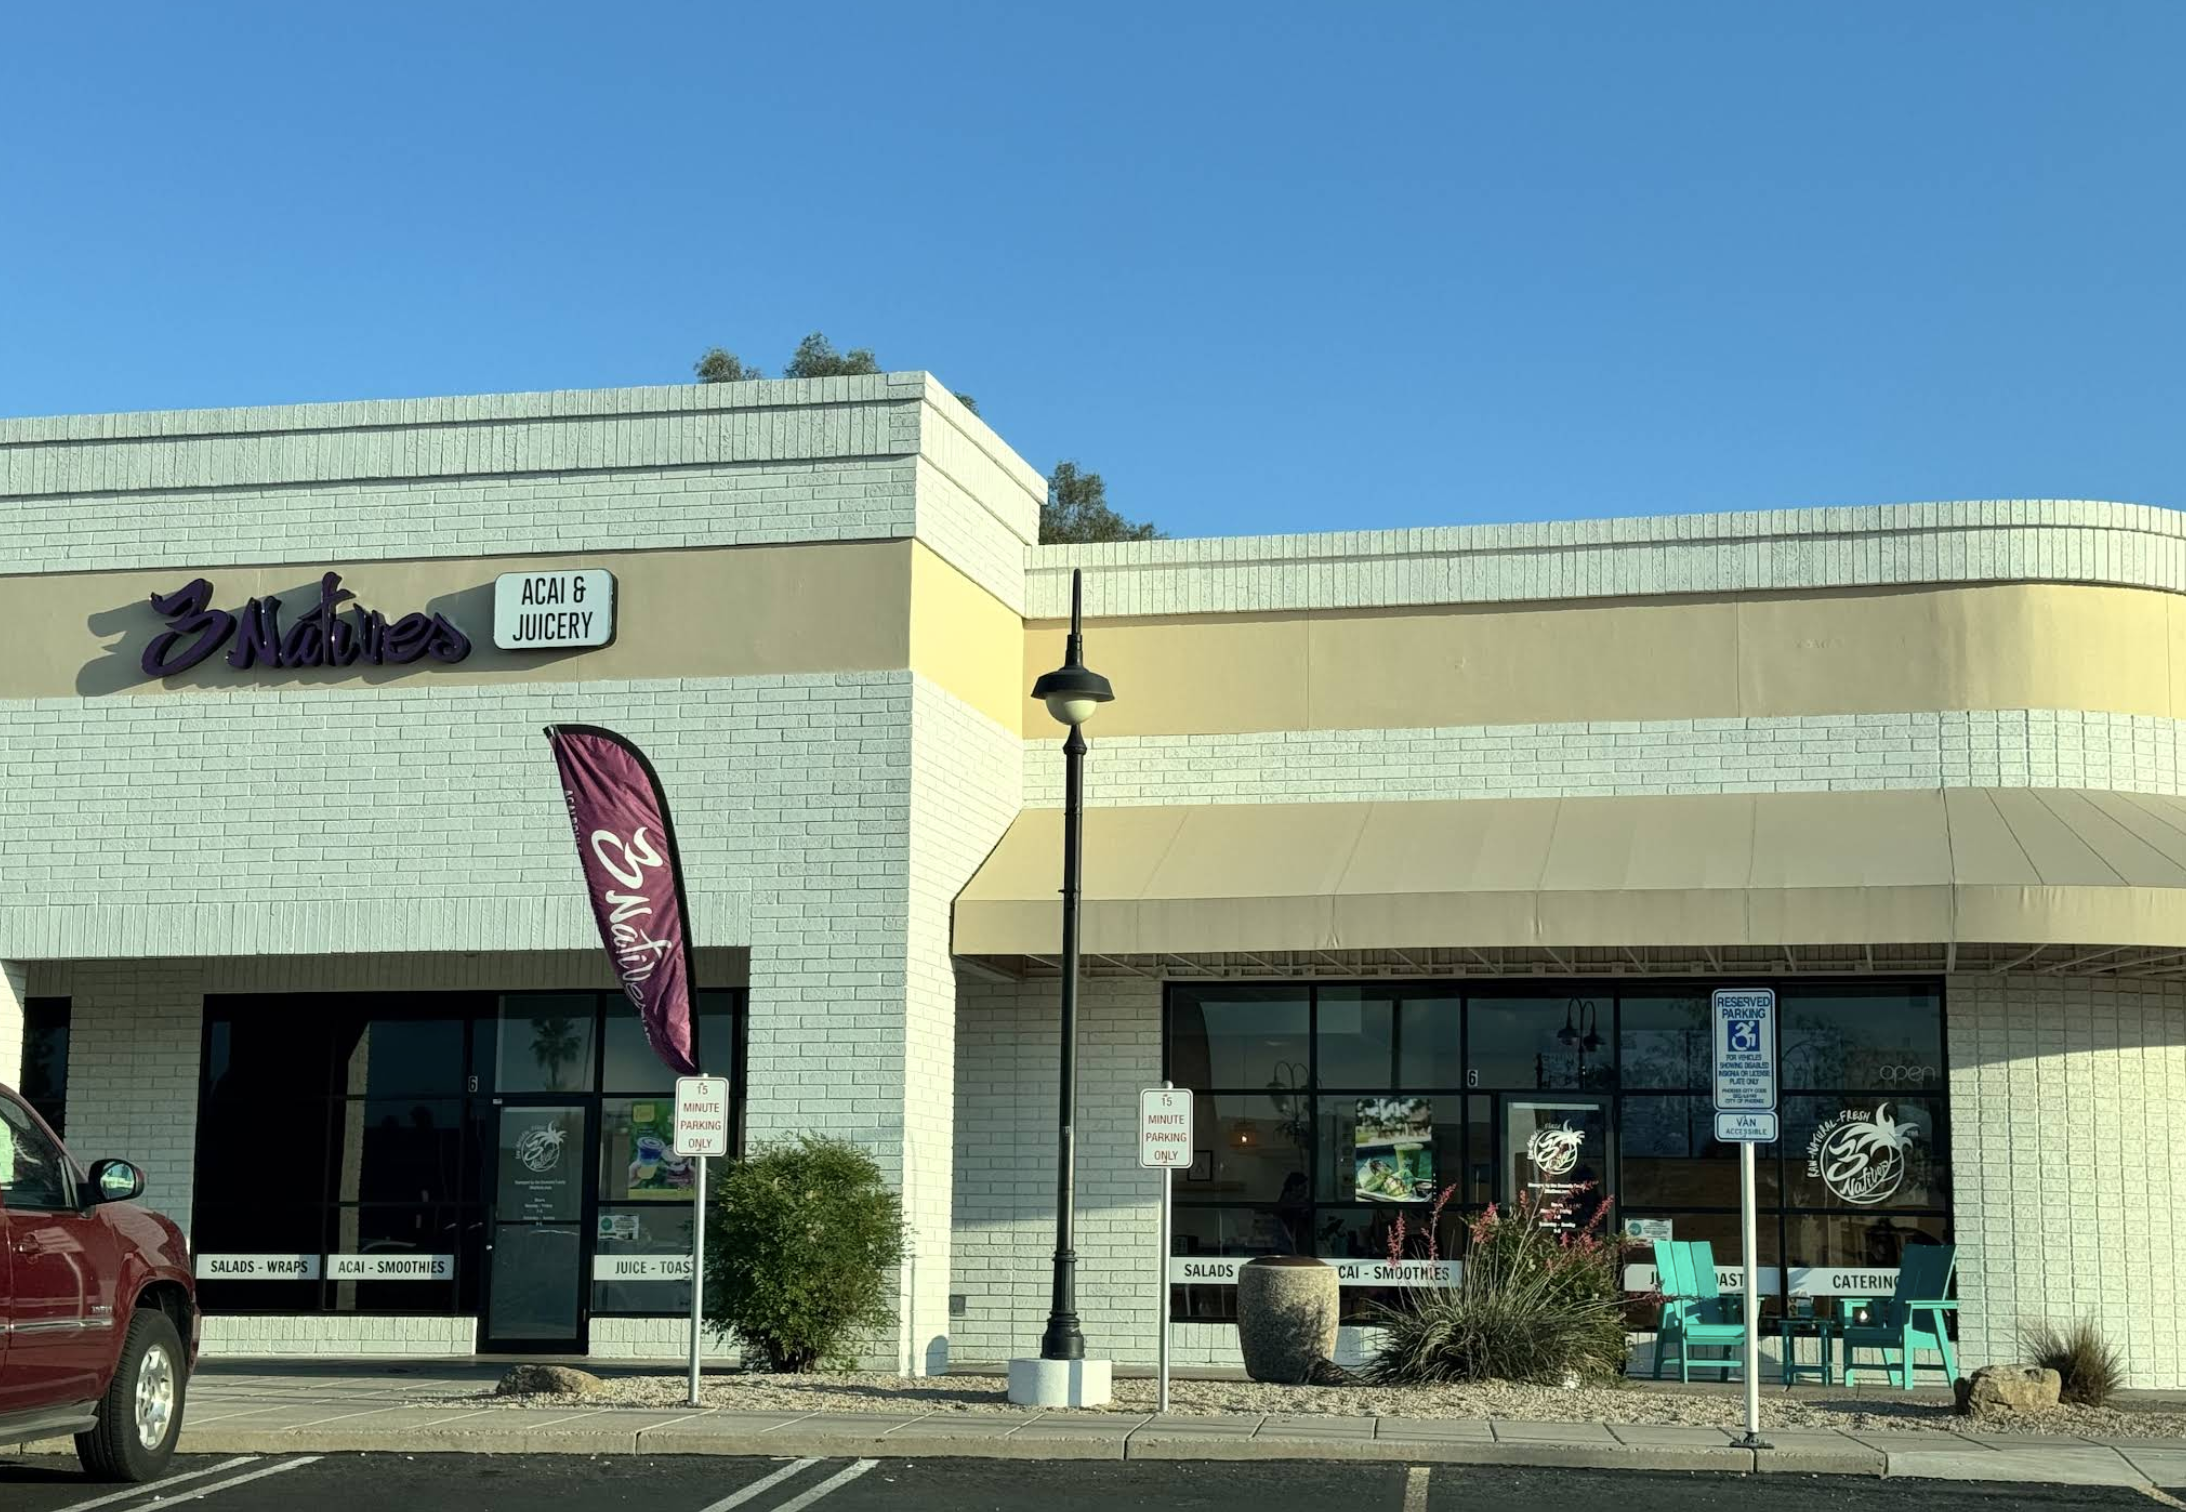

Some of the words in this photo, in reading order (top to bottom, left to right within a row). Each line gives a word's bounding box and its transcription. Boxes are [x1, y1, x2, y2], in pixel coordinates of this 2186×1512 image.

[521, 577, 566, 605] ACAI
[572, 576, 587, 604] &
[142, 578, 237, 677] 3
[226, 571, 472, 669] Natives
[512, 611, 594, 642] JUICERY
[591, 826, 664, 890] 3
[1717, 996, 1771, 1008] RESERVED
[1722, 1008, 1766, 1019] PARKING
[1468, 1070, 1477, 1086] 6
[1879, 1064, 1936, 1084] open
[697, 1084, 708, 1095] 15
[683, 1102, 720, 1113] MINUTE
[1161, 1096, 1173, 1107] 15
[680, 1120, 722, 1131] PARKING
[1148, 1114, 1185, 1125] MINUTE
[1736, 1118, 1757, 1127] VAN
[1145, 1132, 1187, 1142] PARKING
[1726, 1128, 1767, 1136] ACCESSIBLE
[688, 1138, 713, 1149] ONLY
[1154, 1150, 1179, 1161] ONLY
[1827, 1138, 1869, 1182] 3
[210, 1260, 255, 1273] SALADS
[267, 1260, 308, 1273] WRAPS
[338, 1260, 365, 1273] ACAI
[377, 1260, 445, 1274] SMOOTHIES
[615, 1261, 647, 1274] JUICE
[660, 1261, 693, 1274] TOAS
[1184, 1264, 1234, 1278] SALADS
[1338, 1266, 1359, 1279] CAI
[1374, 1266, 1450, 1281] SMOOTHIES
[1716, 1273, 1744, 1287] AST
